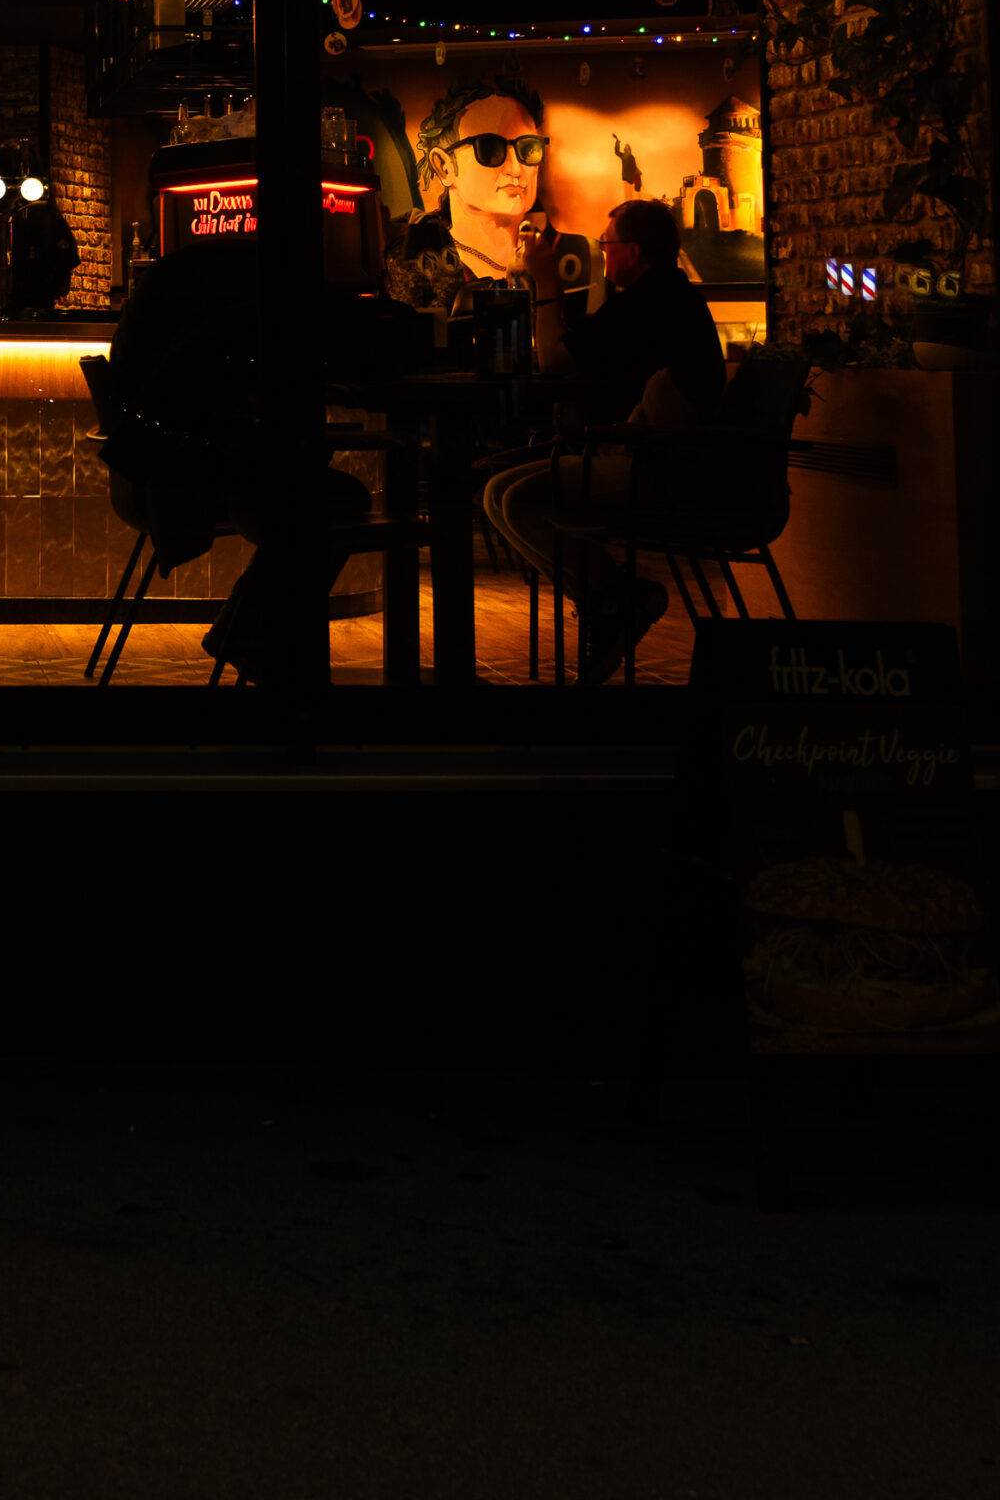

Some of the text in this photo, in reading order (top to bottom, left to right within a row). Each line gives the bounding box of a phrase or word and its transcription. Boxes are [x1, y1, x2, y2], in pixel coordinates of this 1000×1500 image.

[767, 645, 912, 697] fritz-kola
[733, 723, 961, 787] Checkpoint Veggie
